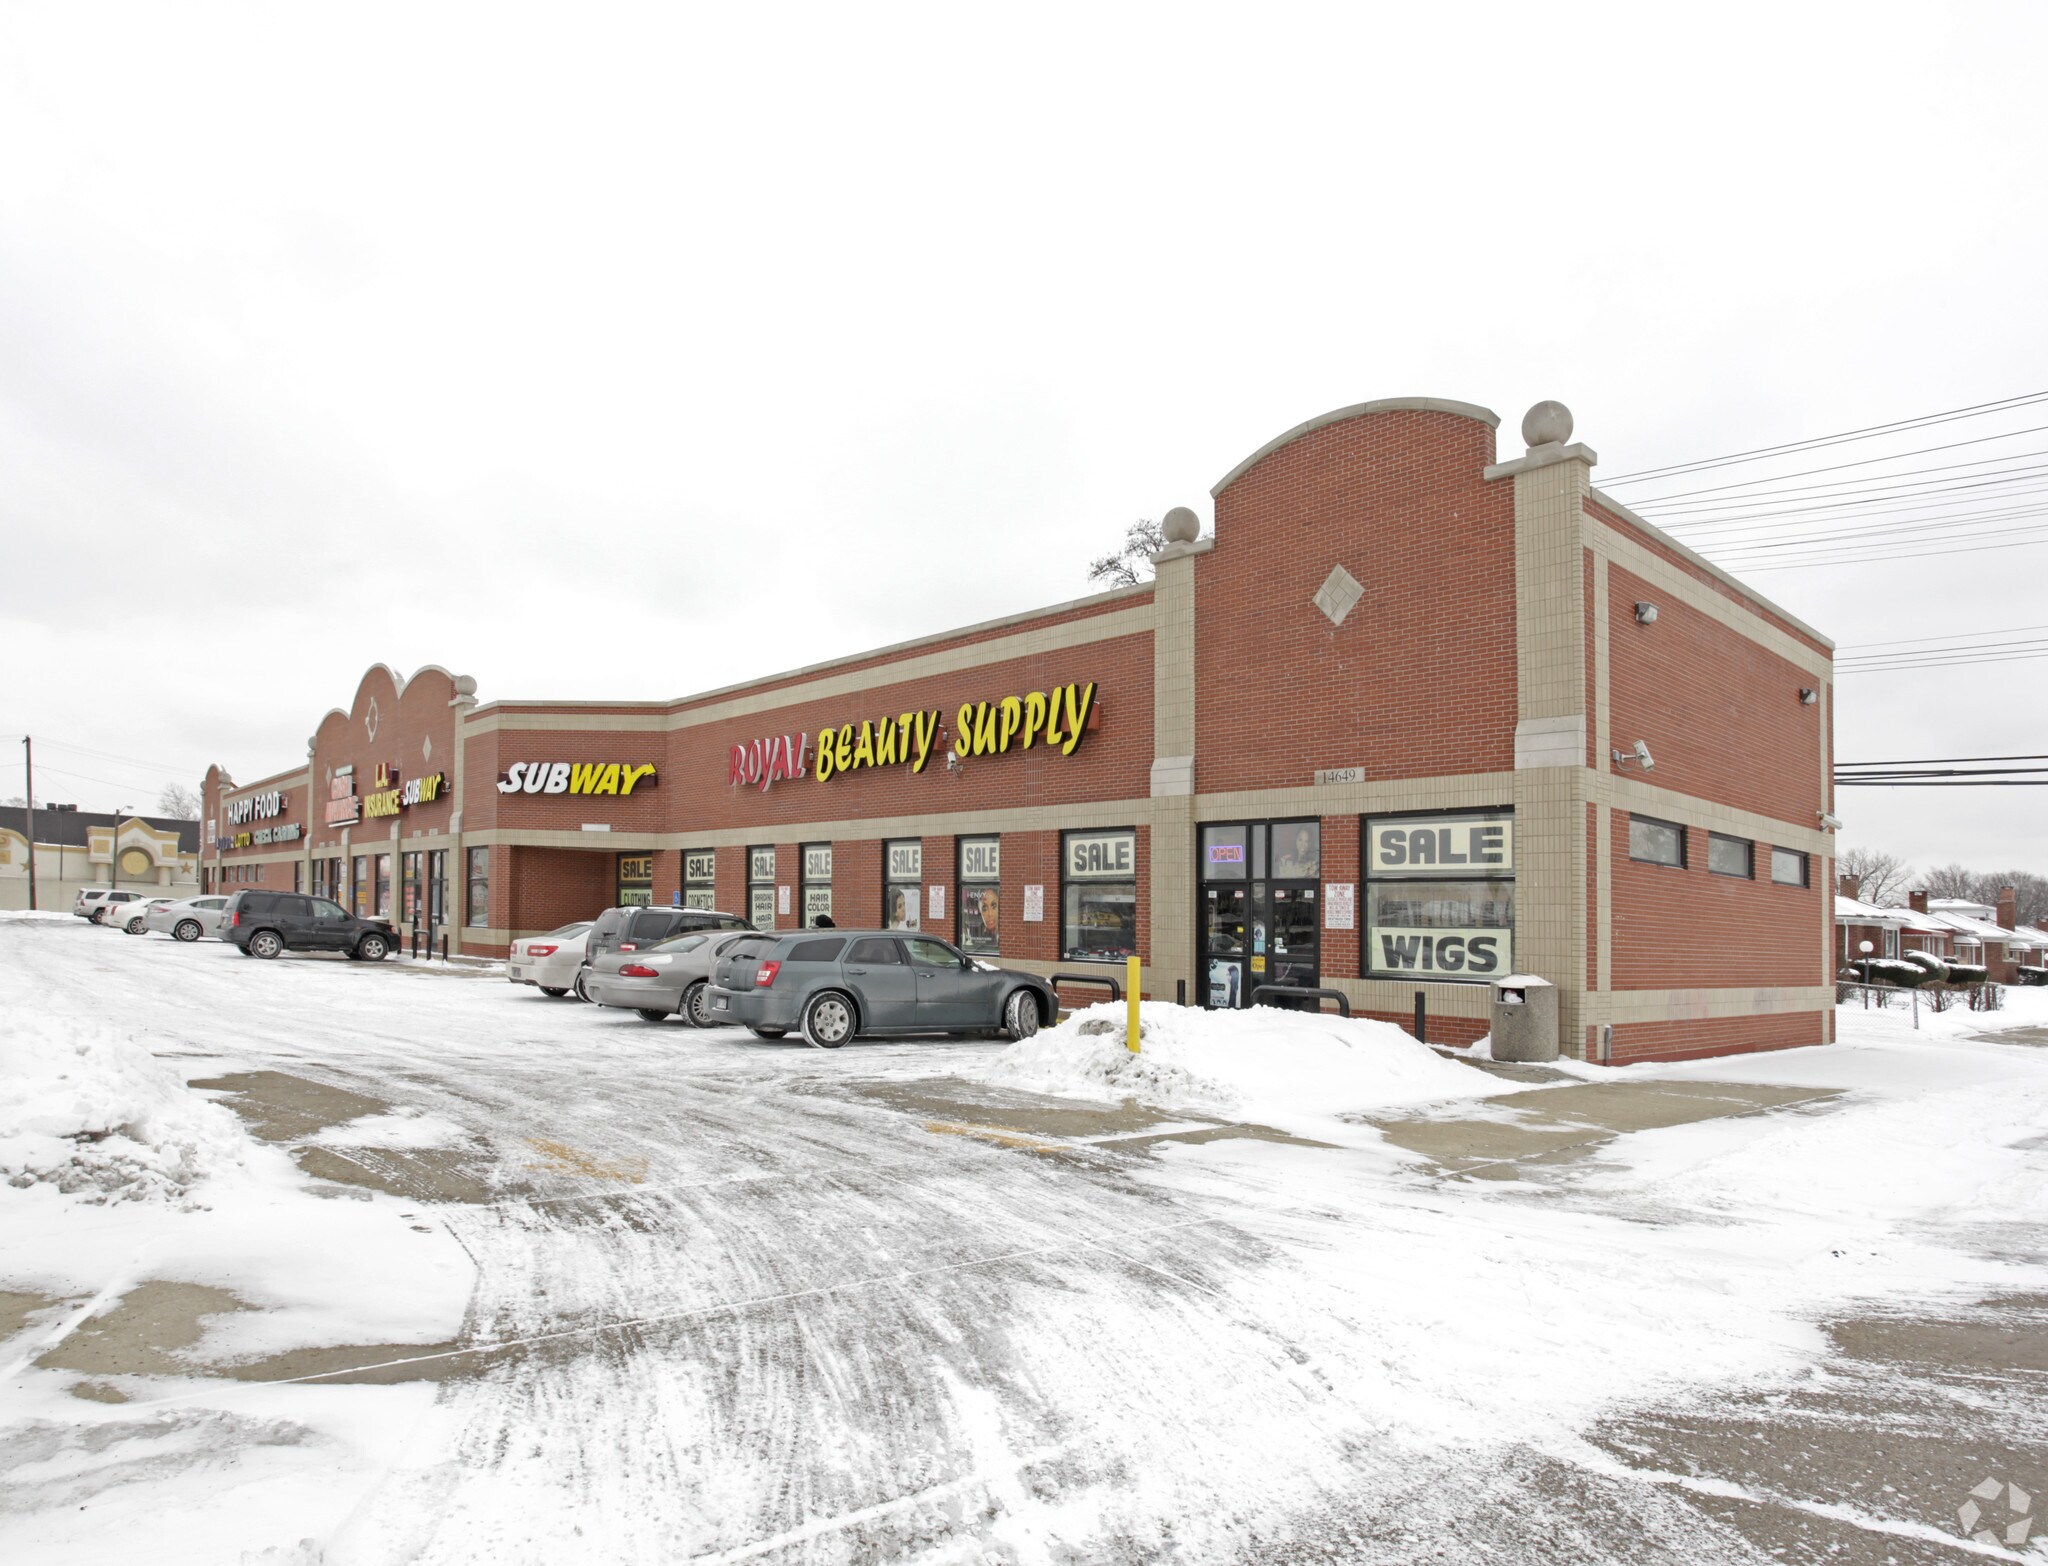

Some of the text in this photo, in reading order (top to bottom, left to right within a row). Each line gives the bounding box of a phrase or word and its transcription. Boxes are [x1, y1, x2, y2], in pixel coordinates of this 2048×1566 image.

[729, 682, 1097, 791] ROYAL BEAUTY SUPPLY
[497, 761, 657, 795] SUBWAY
[1323, 769, 1356, 784] 14649
[401, 773, 443, 806] SUBWAY
[228, 791, 281, 826] HAPPY FOOD
[364, 789, 400, 818] INSURANCE
[234, 832, 252, 848] LOTTO
[1380, 825, 1504, 865] SALE
[808, 853, 831, 875] SALE
[892, 849, 919, 874] SALE
[966, 847, 997, 873] SALE
[1074, 841, 1130, 872] SALE
[1211, 847, 1242, 861] OPEN
[623, 860, 652, 878] SALE
[689, 858, 714, 878] SALE
[754, 855, 774, 877] SALE
[623, 893, 651, 905] CLOTHING
[688, 894, 714, 909] COSMETICS
[755, 902, 773, 911] HAIR
[807, 903, 830, 912] COLOR
[810, 894, 829, 902] HAIR
[755, 913, 772, 923] HAIR
[1381, 934, 1498, 973] WIGS
